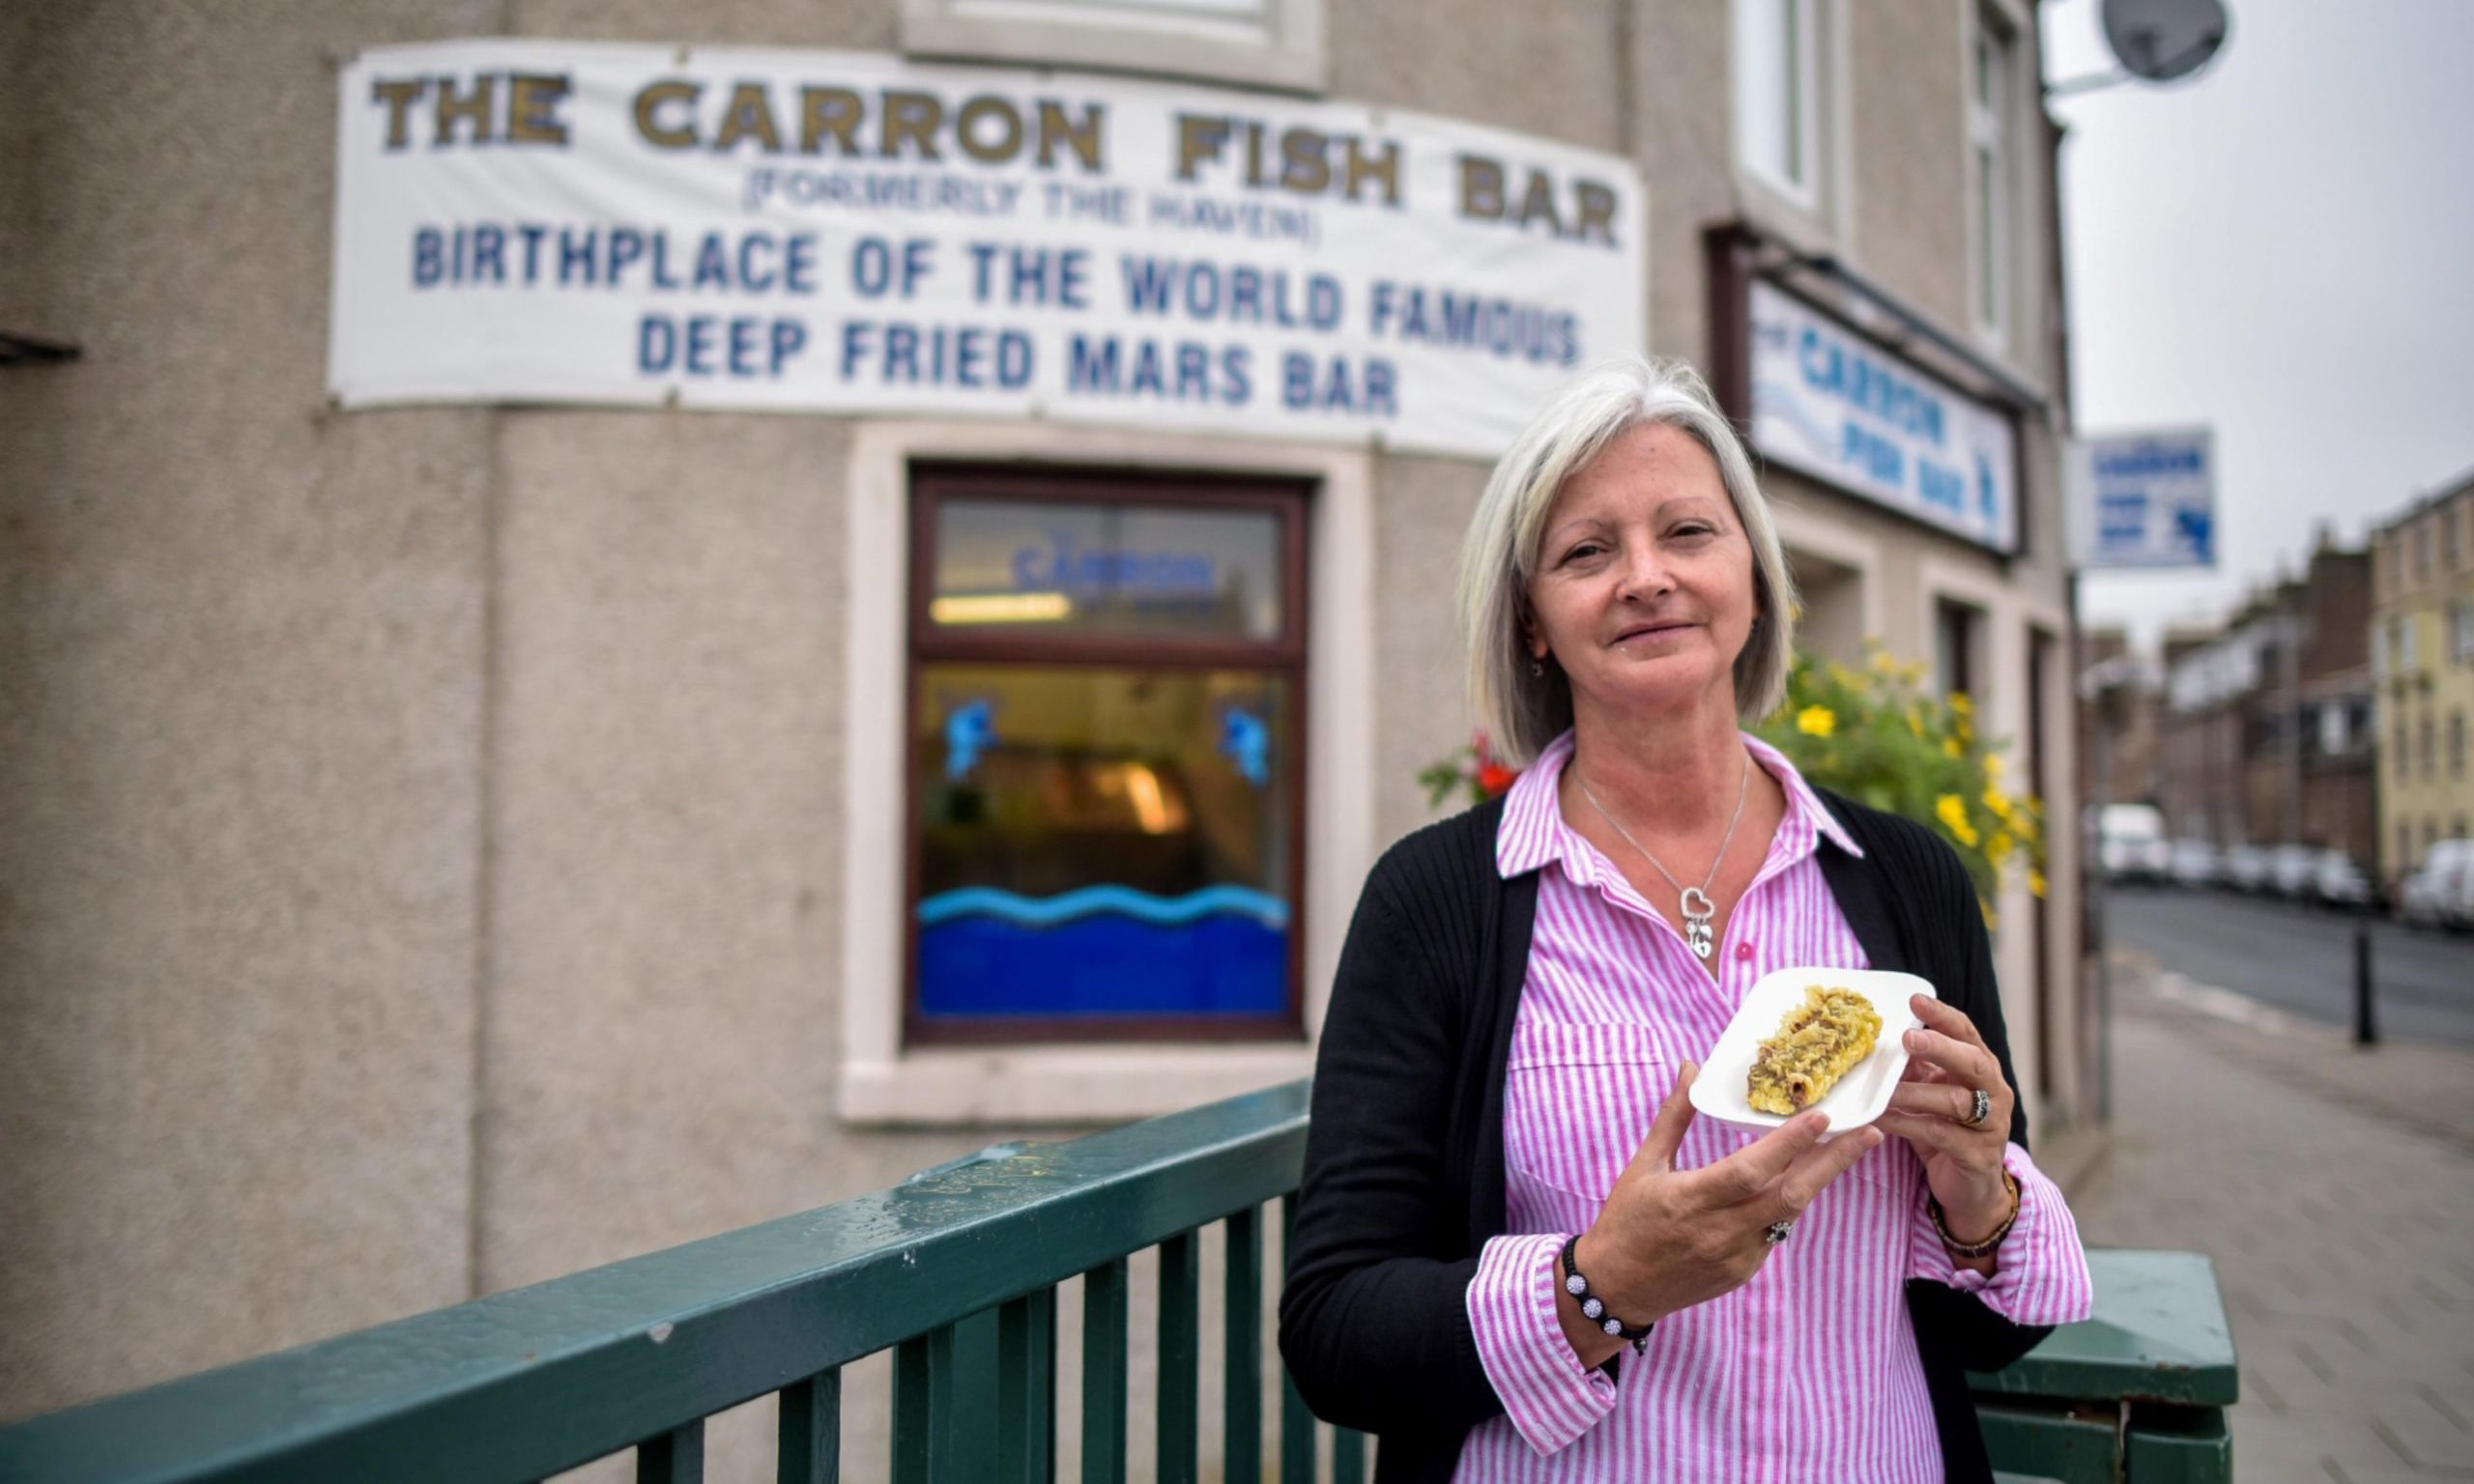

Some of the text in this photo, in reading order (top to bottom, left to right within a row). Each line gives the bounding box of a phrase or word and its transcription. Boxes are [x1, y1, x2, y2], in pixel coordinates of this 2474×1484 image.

[372, 74, 1620, 247] THE CARRON FISH BAR
[1044, 182, 1131, 226] THE
[414, 227, 1579, 364] BIRTHPLACE OF THE WORLD FAMOUS
[636, 314, 1398, 417] DEEP FRIED MARS BAR
